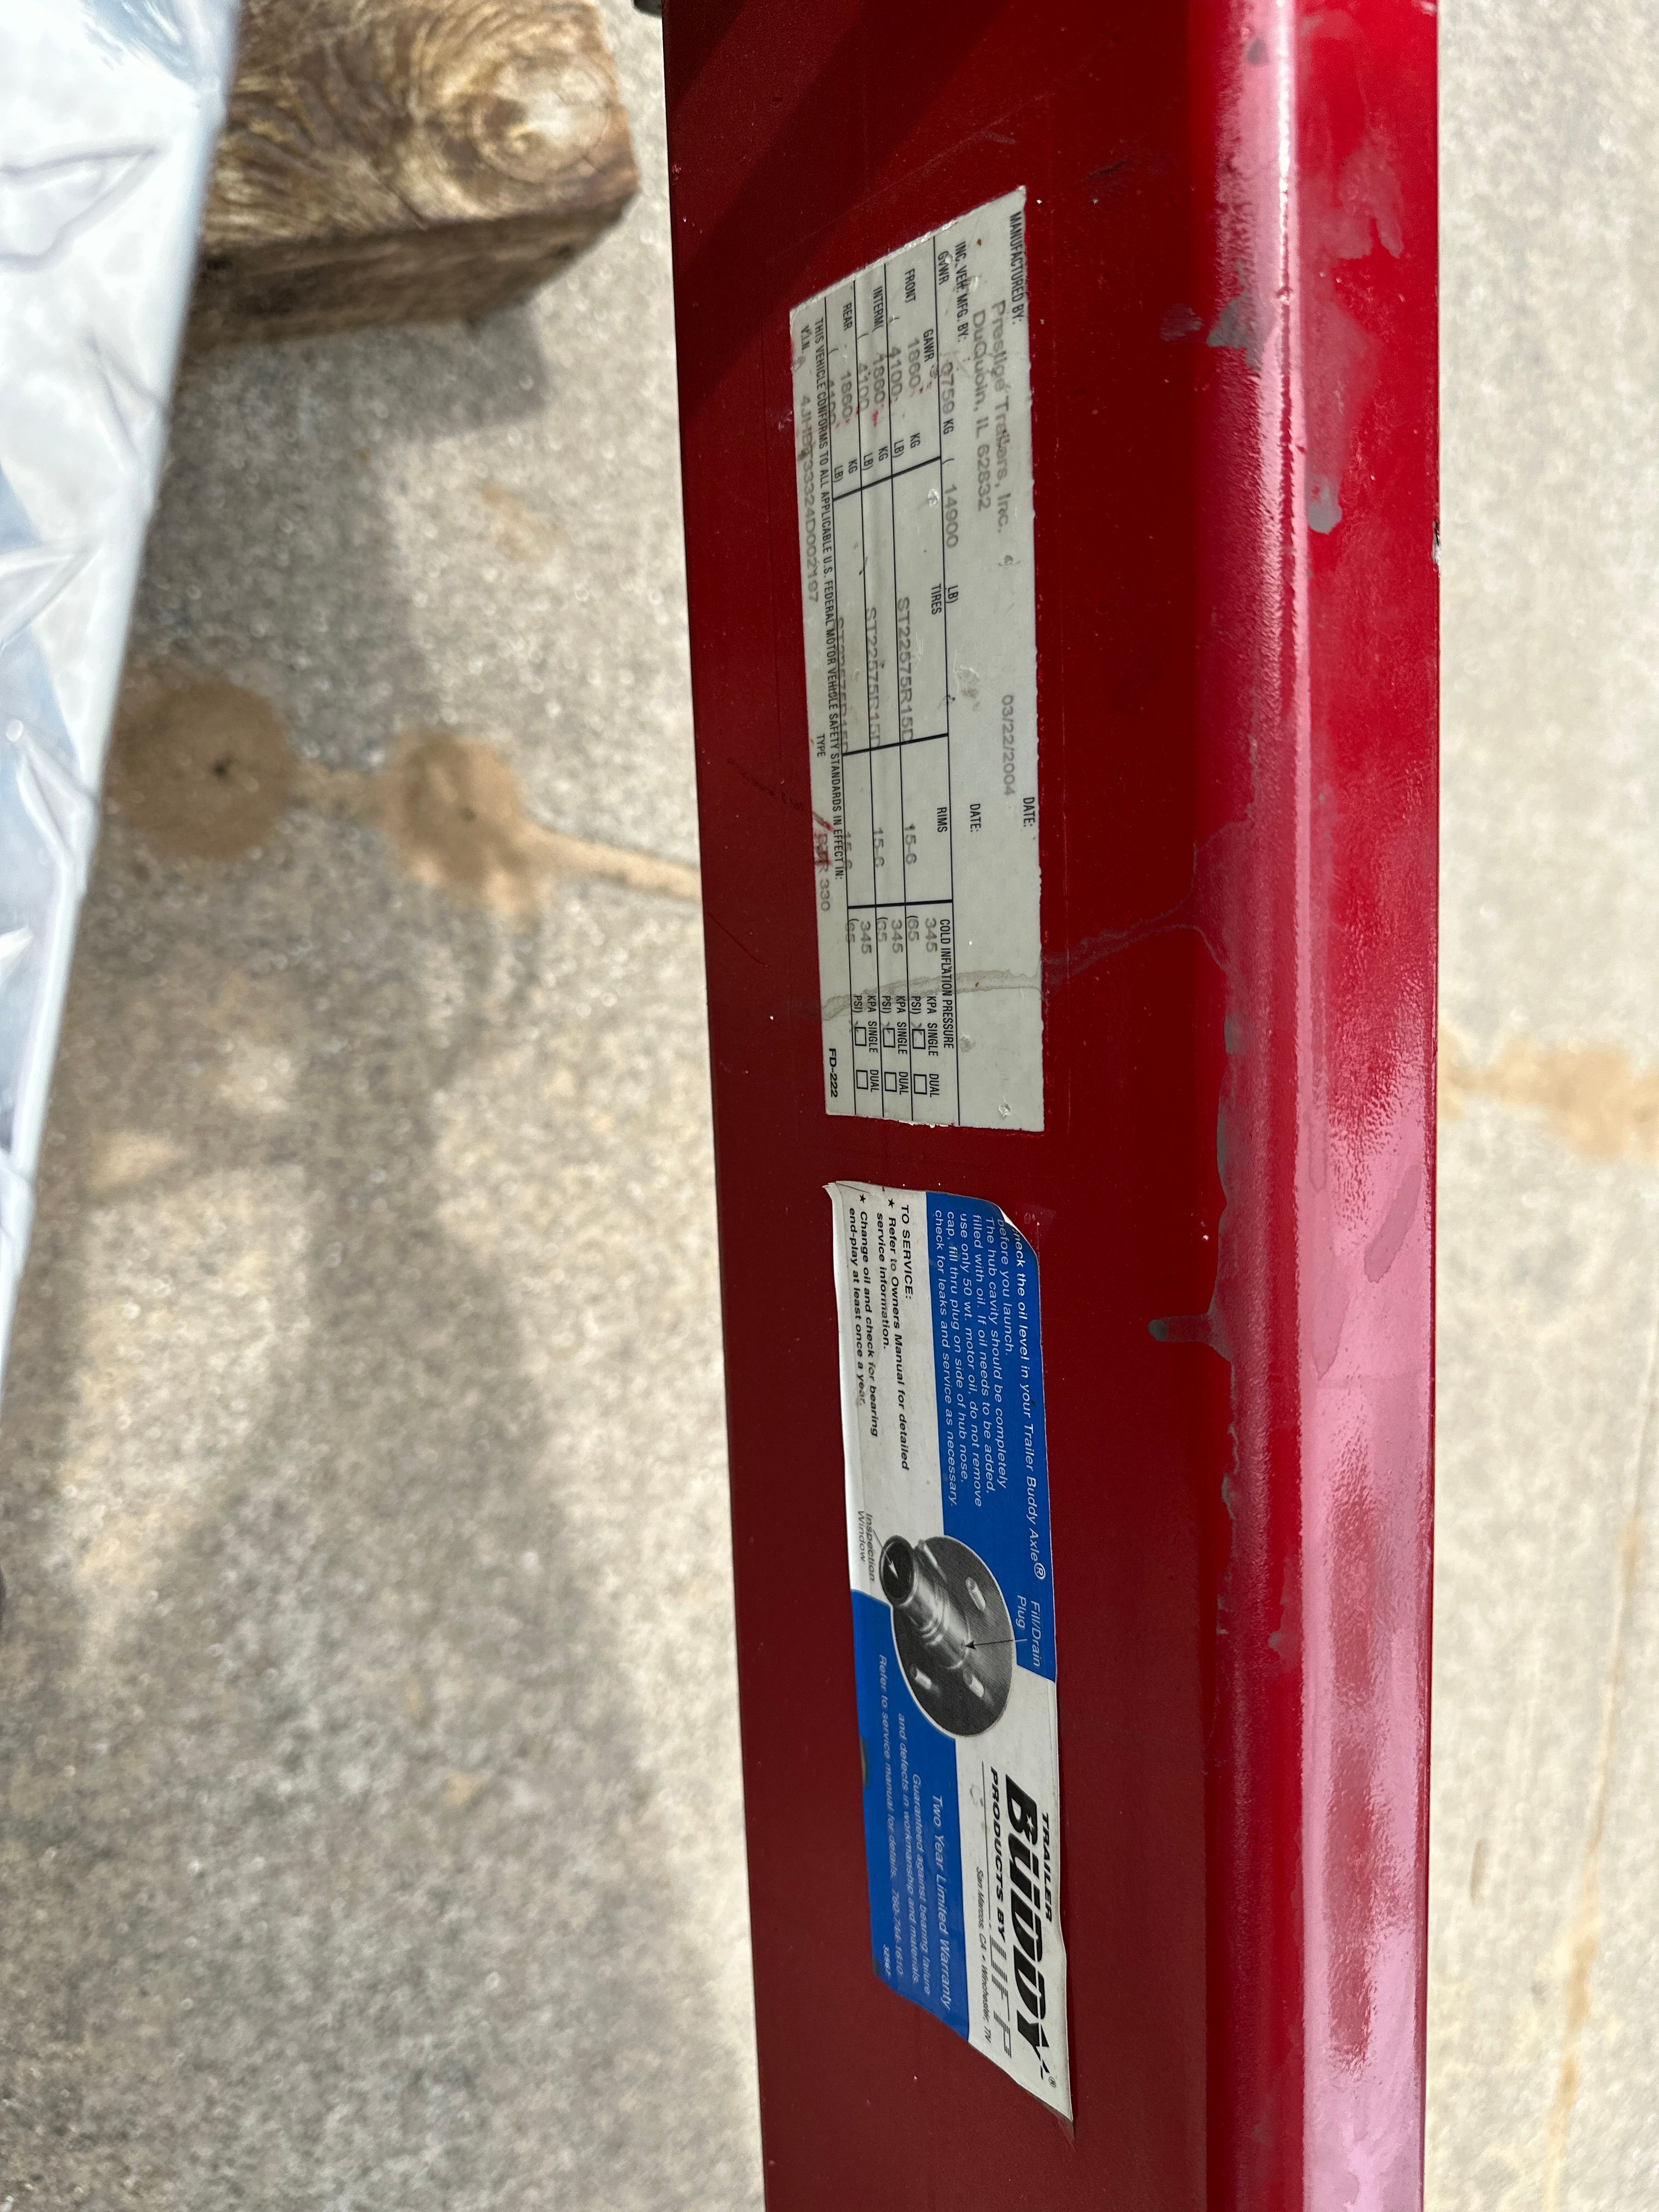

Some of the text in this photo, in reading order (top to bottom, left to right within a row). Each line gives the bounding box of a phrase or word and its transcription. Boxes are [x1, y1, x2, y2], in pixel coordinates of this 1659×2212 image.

[938, 251, 949, 285] GVWR
[955, 241, 968, 342] INC. VEH. MFG. BY:
[1009, 212, 1024, 324] MANUFACTURED BY:
[905, 269, 921, 448] FRONT 1860 KG
[923, 329, 934, 362] GAWR
[843, 302, 857, 473] REAR KG
[972, 311, 991, 511] DuQuoin, 62832
[878, 446, 888, 461] KG
[892, 439, 904, 458] LB)
[943, 419, 954, 435] KG
[945, 485, 959, 548] 14900
[997, 494, 1011, 533] Inc.
[814, 318, 843, 862] THIS VEHICLE CONFORMS TO ALL APPLICABLE U.S. FEDERAL MOTOR VEHICLE SAFETY STANDARDS IN EFFECT
[931, 583, 941, 614] TIRES
[946, 585, 959, 603] LB)
[816, 734, 825, 758] TYPE
[1002, 695, 1015, 795] 03/22/2004
[937, 807, 947, 833] RIMS
[970, 804, 981, 832] DATE:
[1023, 797, 1035, 827] DATE:
[820, 879, 831, 911] 330
[905, 823, 922, 1014] 15-6 PSI)
[851, 995, 862, 1013] PSI)
[860, 921, 879, 1092] 345 KPA SINGLE DUAL
[881, 995, 891, 1013] PSI)
[891, 919, 909, 1094] 345 KPA SINGLE DUAL
[926, 917, 939, 1098] 345 KPA SINGLE DUAL
[940, 919, 953, 1048] COLD INFLATION PRESSURE
[829, 1048, 838, 1097] FD-222
[849, 1207, 859, 1266] end-play
[860, 1211, 870, 1262] Change
[901, 1204, 912, 1299] TO SERVICE:
[960, 1244, 970, 1273] only
[853, 1271, 860, 1283] at
[877, 1213, 890, 1349] service information.
[963, 1278, 972, 1295] 50
[997, 1219, 1014, 1356] before you launch.
[866, 1317, 876, 1357] check
[889, 1217, 910, 1470] Refer to Owners Manual for detailed
[935, 1210, 957, 1506] check for leaks and service as necessary.
[946, 1211, 968, 1482] cap, fill thru plug on side of hub nose,
[966, 1328, 975, 1369] motor
[973, 1215, 995, 1493] filled with oil. If oil needs to be added,
[986, 1217, 1008, 1488] The hub cavity should be completely
[868, 1362, 877, 1381] for
[968, 1374, 977, 1394] oil,
[1017, 1273, 1037, 1524] the oil level in your Trailer Buddy
[869, 1385, 879, 1437] bearing
[969, 1401, 979, 1418] do
[970, 1424, 979, 1448] not
[972, 1452, 982, 1506] remove
[857, 1511, 876, 1581] Inspection Window
[1016, 1595, 1041, 1667] Fill/Drain Plug
[991, 1767, 1003, 1905] PRODUCTS
[997, 1908, 1006, 1941] BY
[1042, 1813, 1052, 1922] TRAILER
[933, 1795, 952, 2010] Two Year Limited Warranty
